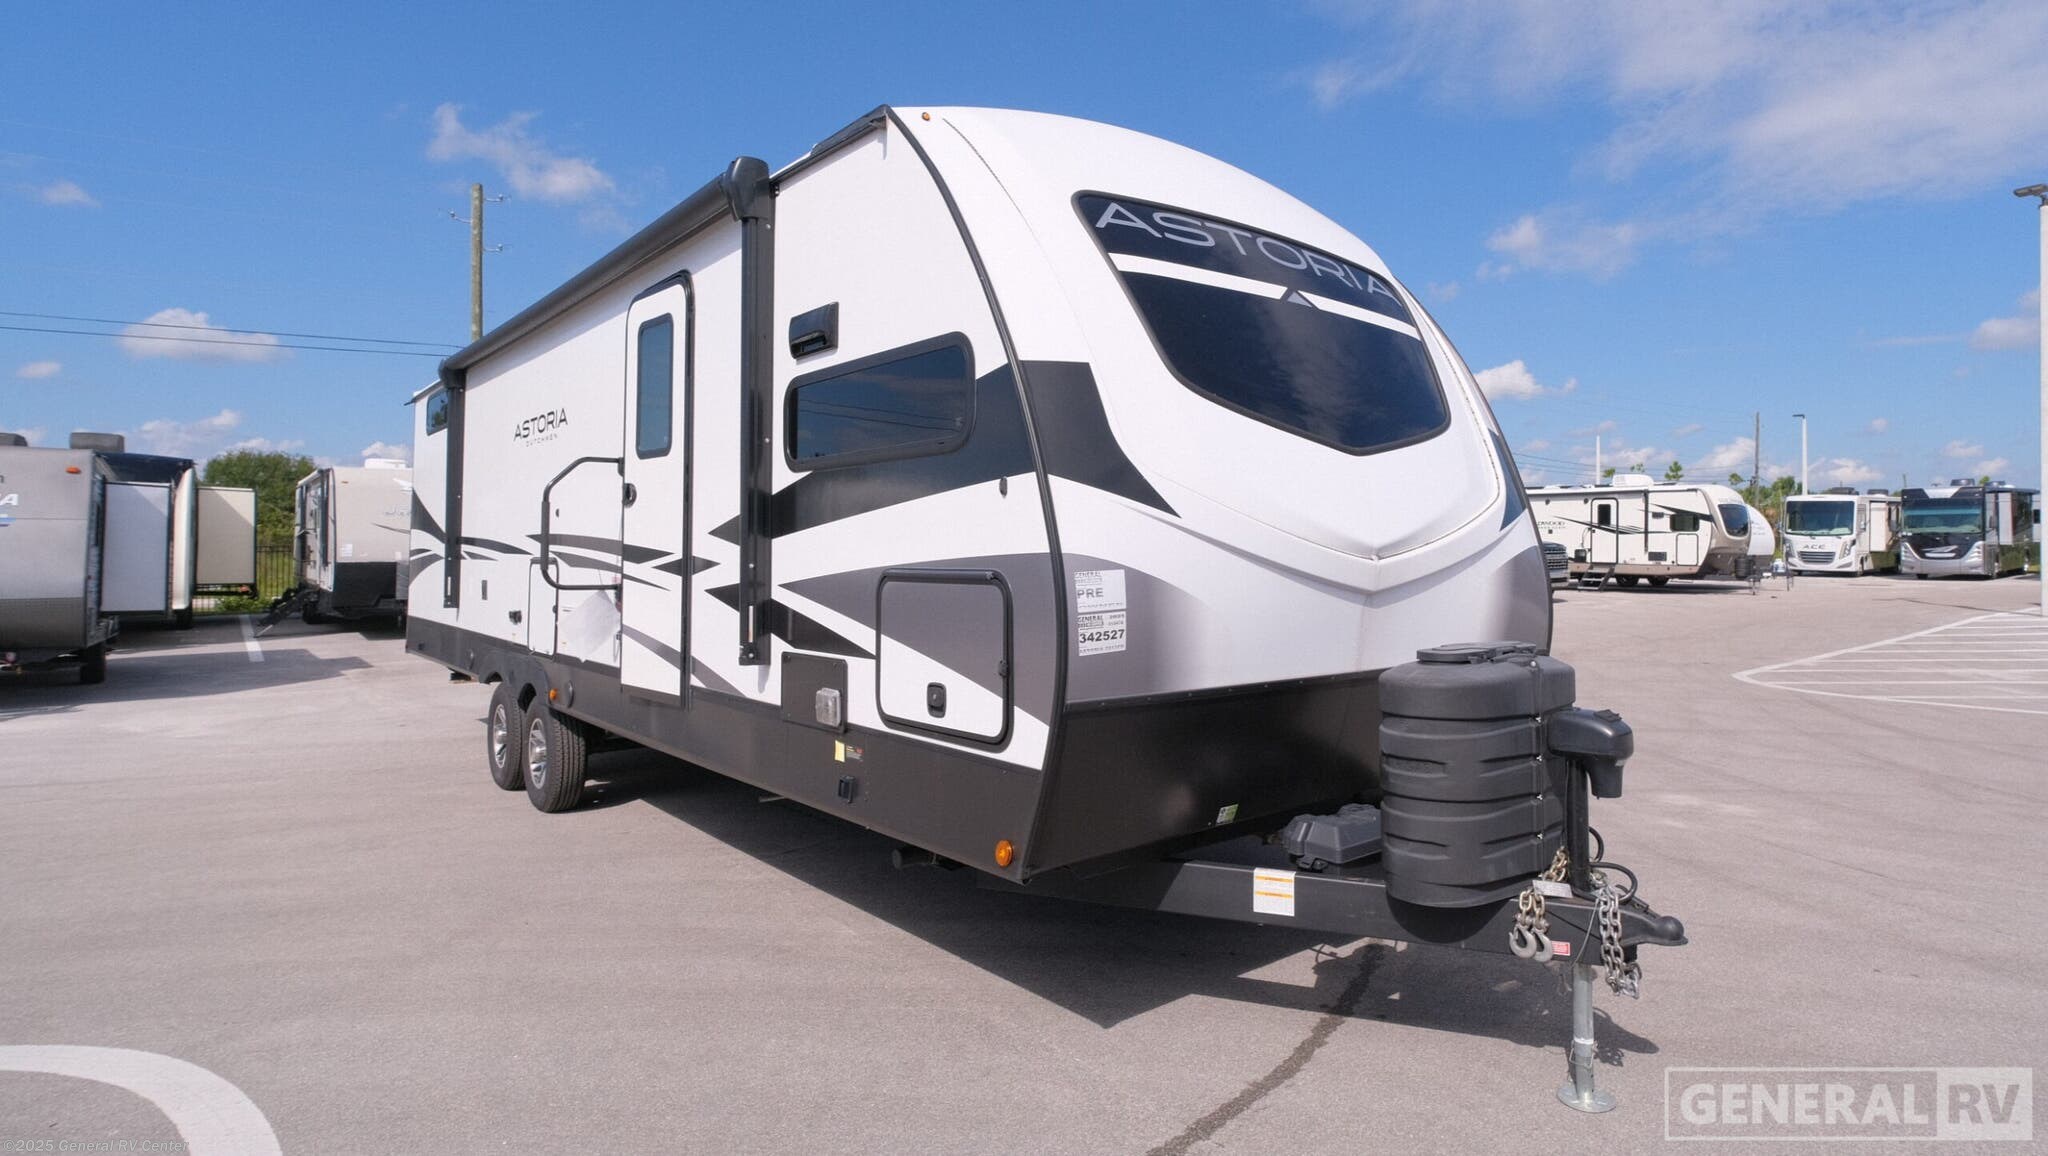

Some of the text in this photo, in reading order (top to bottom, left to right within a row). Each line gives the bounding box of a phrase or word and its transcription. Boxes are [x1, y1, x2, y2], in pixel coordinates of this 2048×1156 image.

[1096, 202, 1402, 307] ASTORIA
[513, 407, 568, 442] ASTORIA
[1077, 587, 1104, 599] PRE
[1079, 629, 1125, 644] 342527
